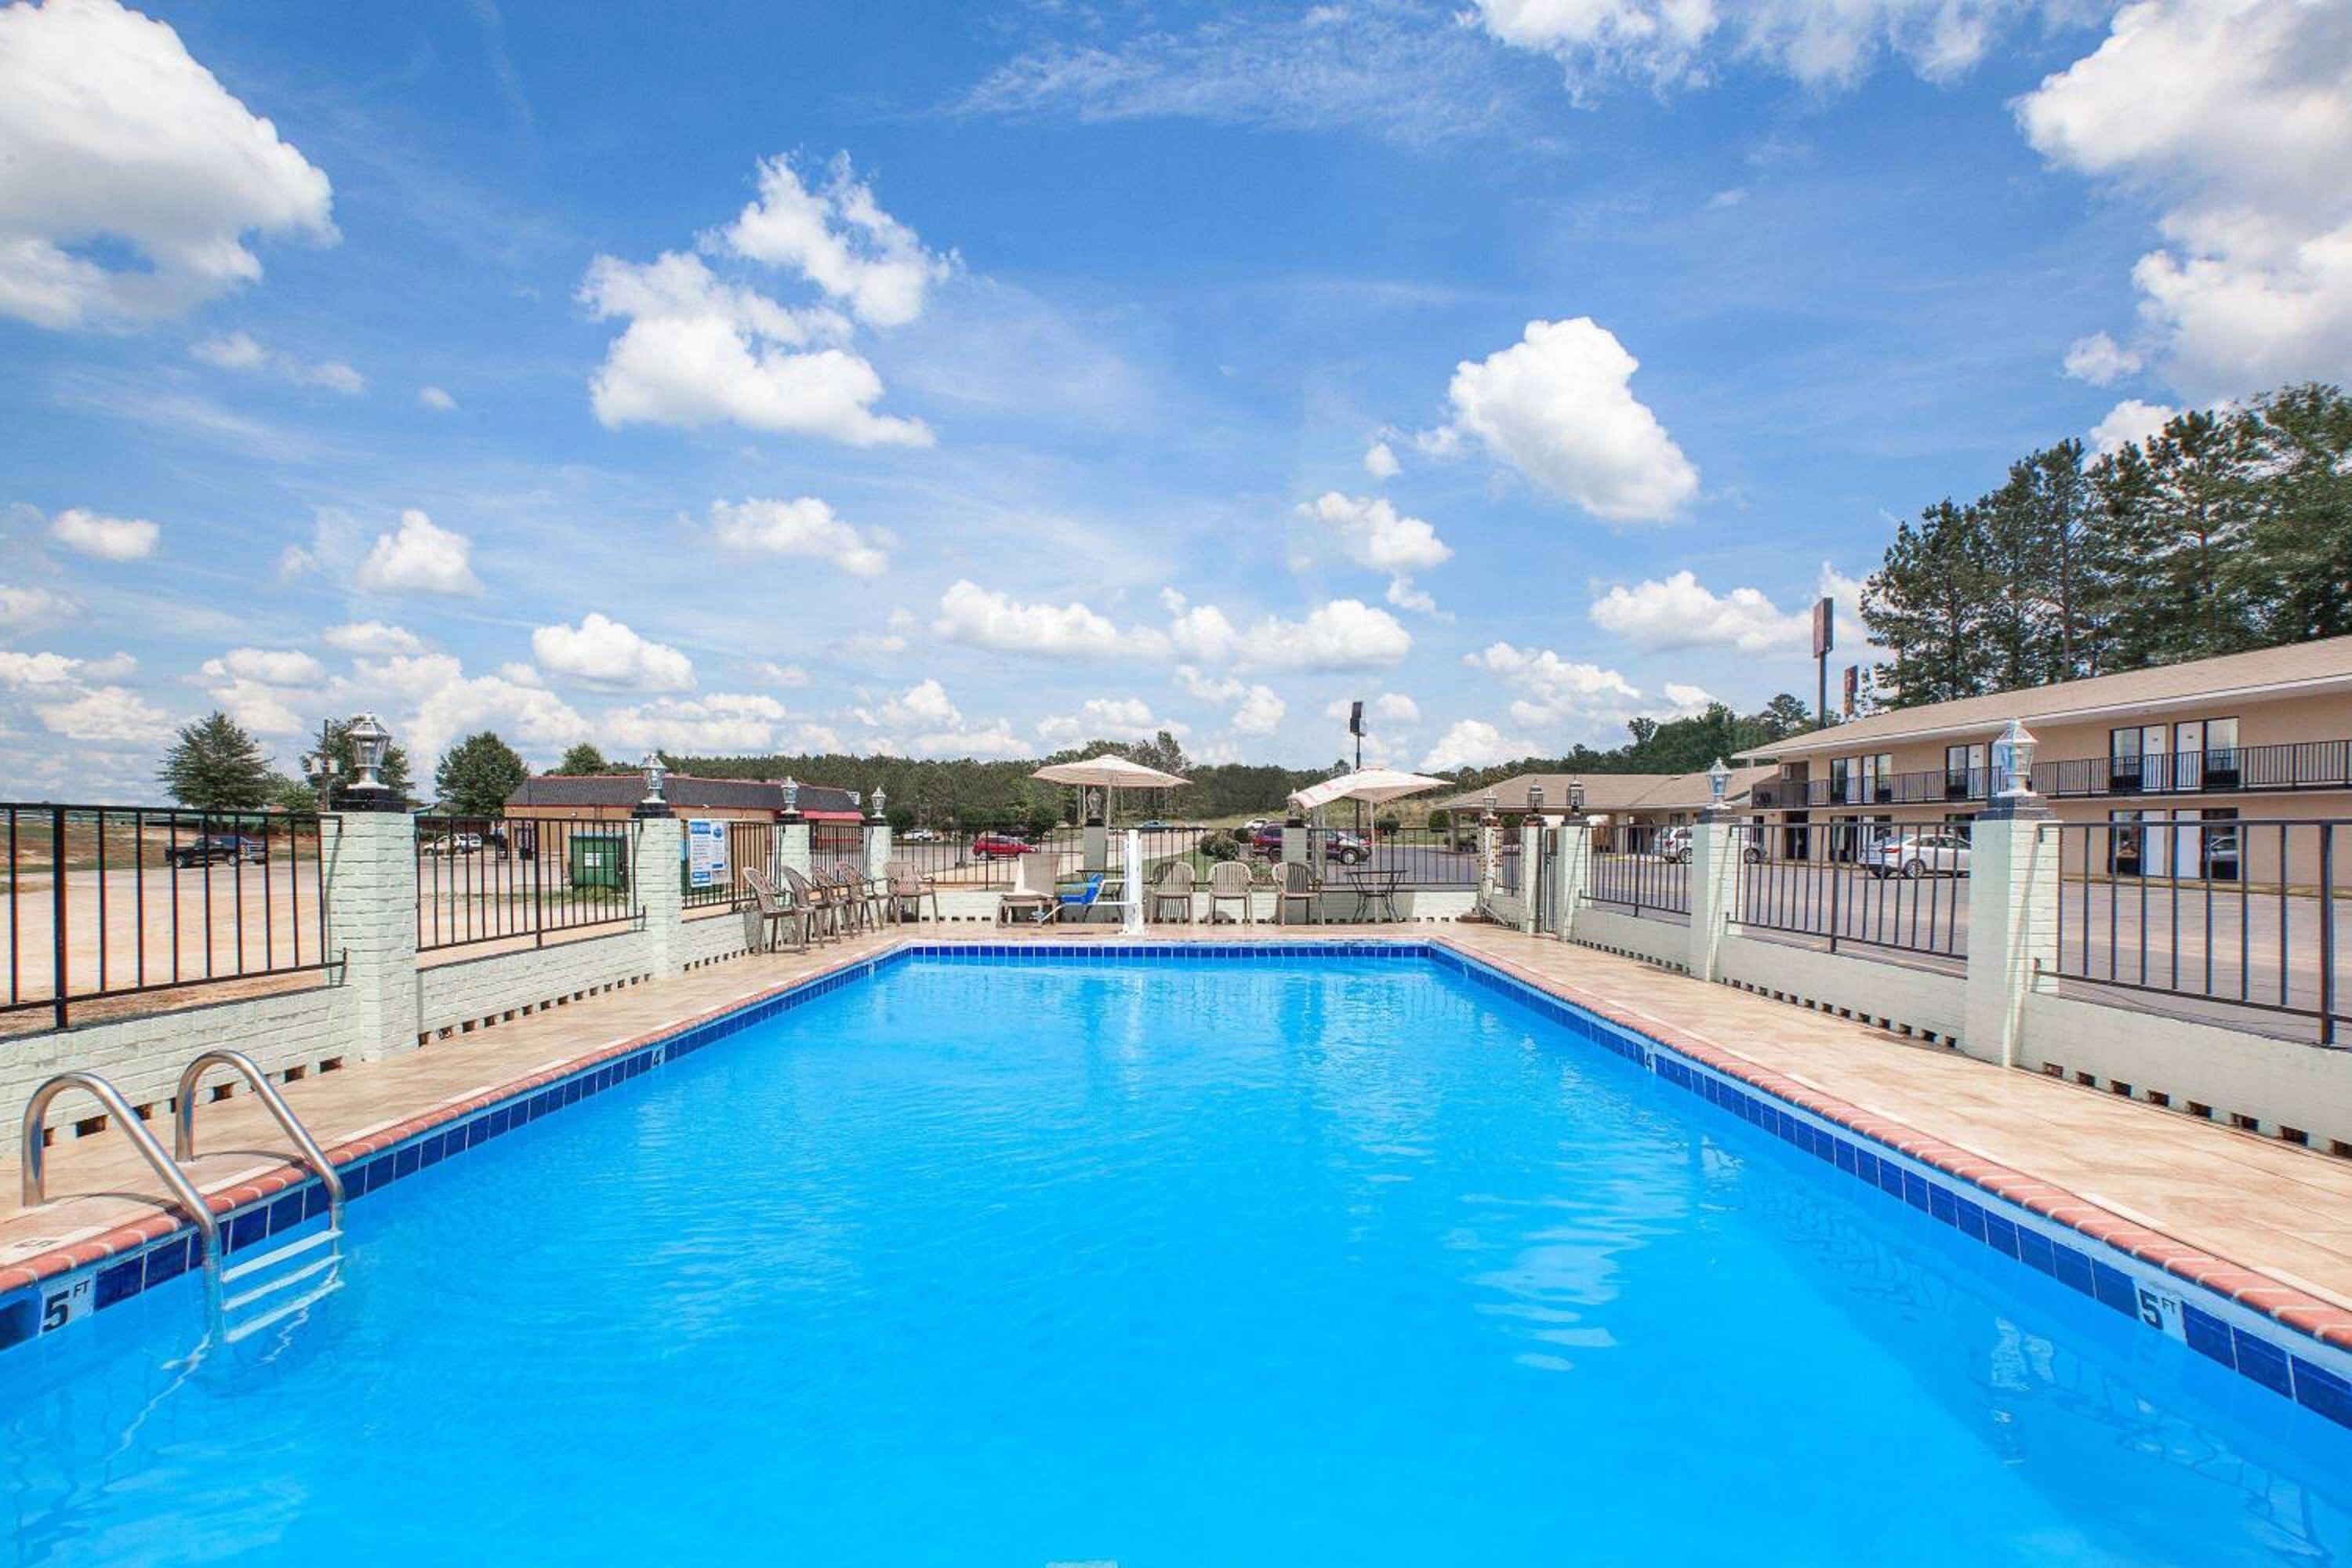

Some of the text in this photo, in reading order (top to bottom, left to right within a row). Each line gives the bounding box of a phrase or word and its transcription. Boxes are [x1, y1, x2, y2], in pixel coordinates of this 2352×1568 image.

[42, 1279, 90, 1331] 5 FT
[2139, 1288, 2176, 1330] 5 FT
